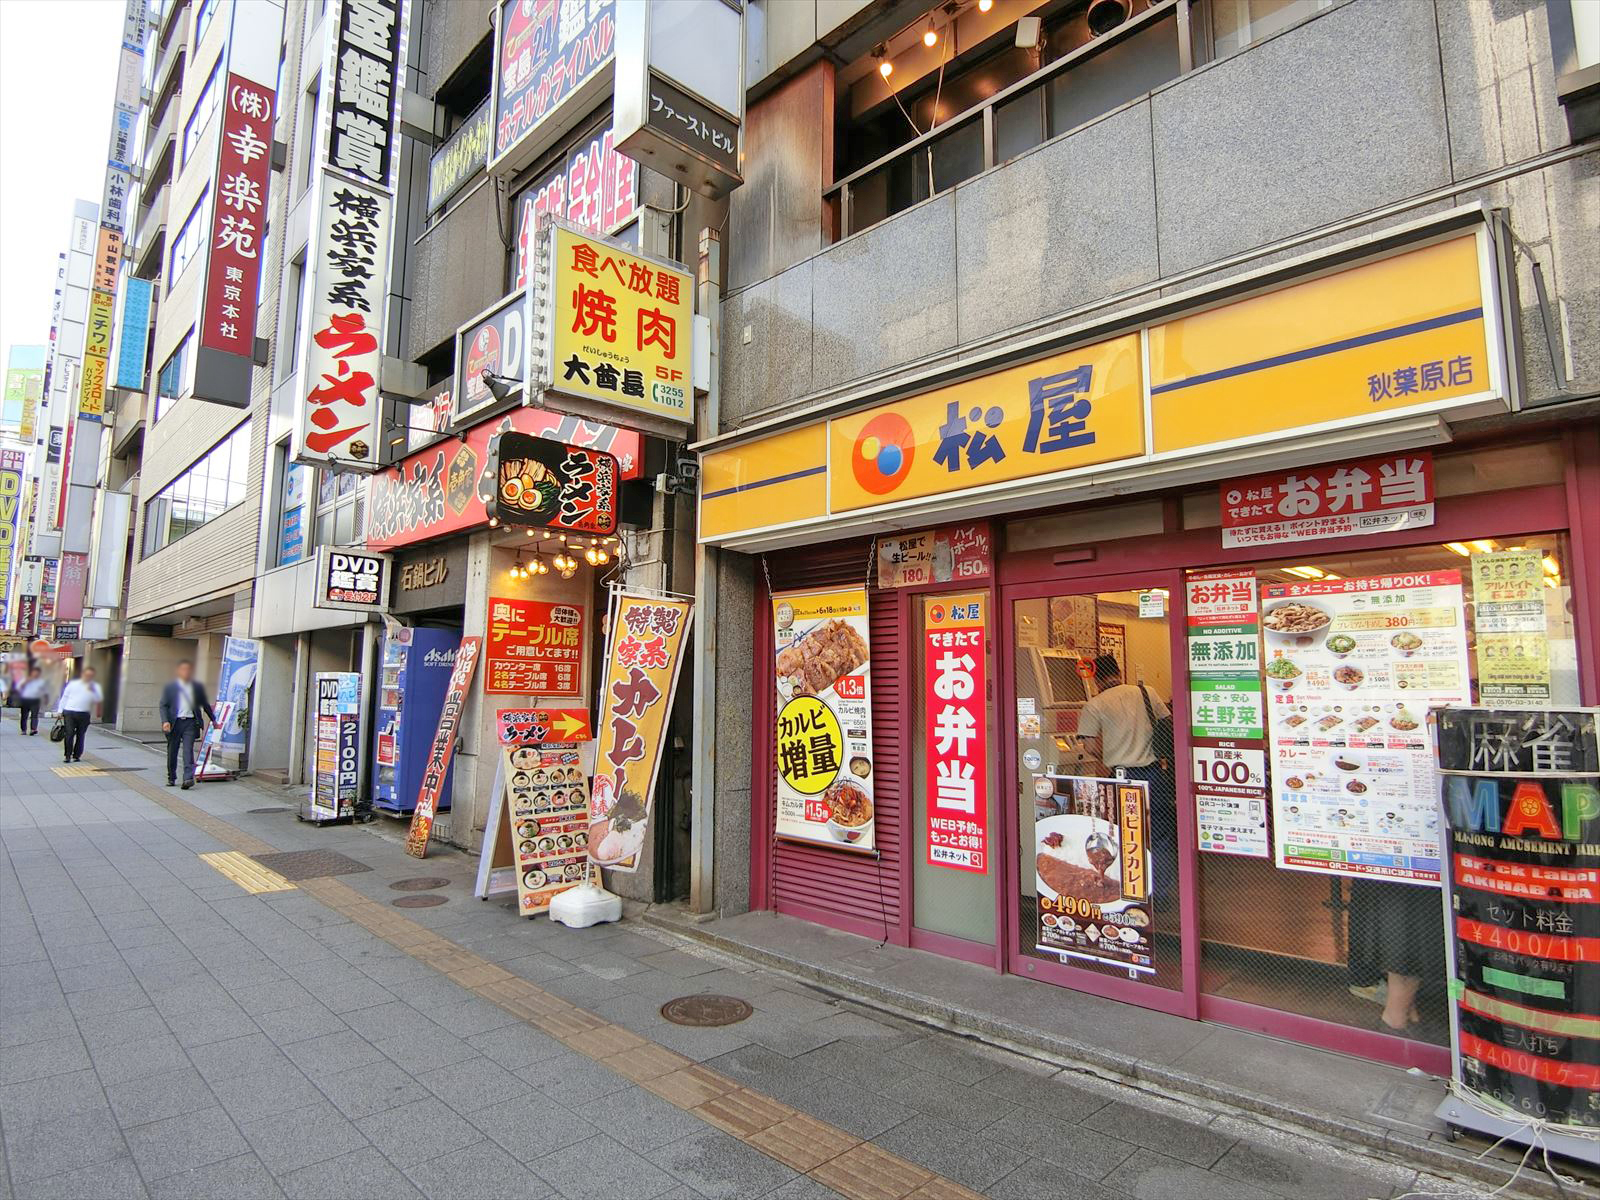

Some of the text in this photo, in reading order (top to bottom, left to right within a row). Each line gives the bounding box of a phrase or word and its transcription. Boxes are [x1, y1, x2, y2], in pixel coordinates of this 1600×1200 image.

[498, 12, 614, 150] ホテルがライバル
[651, 92, 735, 155] ファーストビル
[216, 84, 271, 259] (株)幸楽苑
[571, 243, 680, 305] 食べ放題
[220, 265, 244, 340] 東京本社
[572, 282, 676, 360] 焼肉
[563, 354, 645, 398] 大酋長
[655, 365, 683, 382] 5F
[1367, 355, 1473, 402] 秋葉原店
[660, 384, 684, 398] 3255
[660, 394, 684, 409] 1012
[932, 364, 1097, 474] 松屋
[558, 452, 595, 526] ラーメン
[1246, 487, 1273, 501] 松屋
[1277, 459, 1426, 518] お弁当
[1229, 503, 1273, 518] できたて
[899, 536, 926, 552] 松屋で
[954, 527, 976, 540] ハイ
[332, 554, 380, 575] DVD
[401, 558, 449, 592] 石鍋ビル
[1190, 581, 1252, 604] お弁当
[1289, 574, 1431, 596] 全メニューお持ち帰りOK!
[492, 603, 525, 623] 奥に
[624, 605, 681, 636] 特製
[950, 603, 979, 620] 松屋
[491, 622, 580, 647] テーブル席
[928, 631, 980, 647] できたて
[506, 645, 579, 659] ご用意してます!!
[617, 635, 671, 670] 家系
[1191, 640, 1257, 661] 無添加
[494, 662, 572, 673] カウンター席 16席
[494, 670, 571, 682] 2名テーブル席 6席
[321, 681, 338, 698] DVD
[493, 680, 571, 690] 4名テーブル席 3席
[1202, 693, 1250, 703] 安全・安心
[779, 703, 826, 740] カルビ
[1196, 705, 1257, 725] 生野菜
[503, 725, 551, 742] ラーメン
[604, 666, 662, 802] カレー
[933, 651, 977, 815] お弁当
[1468, 711, 1576, 772] 麻雀
[339, 721, 359, 785] 2100円
[780, 732, 840, 781] 増量
[1214, 750, 1243, 760] 国産米
[1279, 749, 1307, 758] カレー
[1197, 759, 1262, 785] 100%
[1451, 778, 1600, 841] MAP
[930, 830, 983, 849] もっとお得!
[1500, 837, 1572, 855] AMUSEMENT
[1530, 867, 1597, 883] Label
[1486, 902, 1575, 934] セット料金
[1502, 1028, 1560, 1056] 三人打ち
